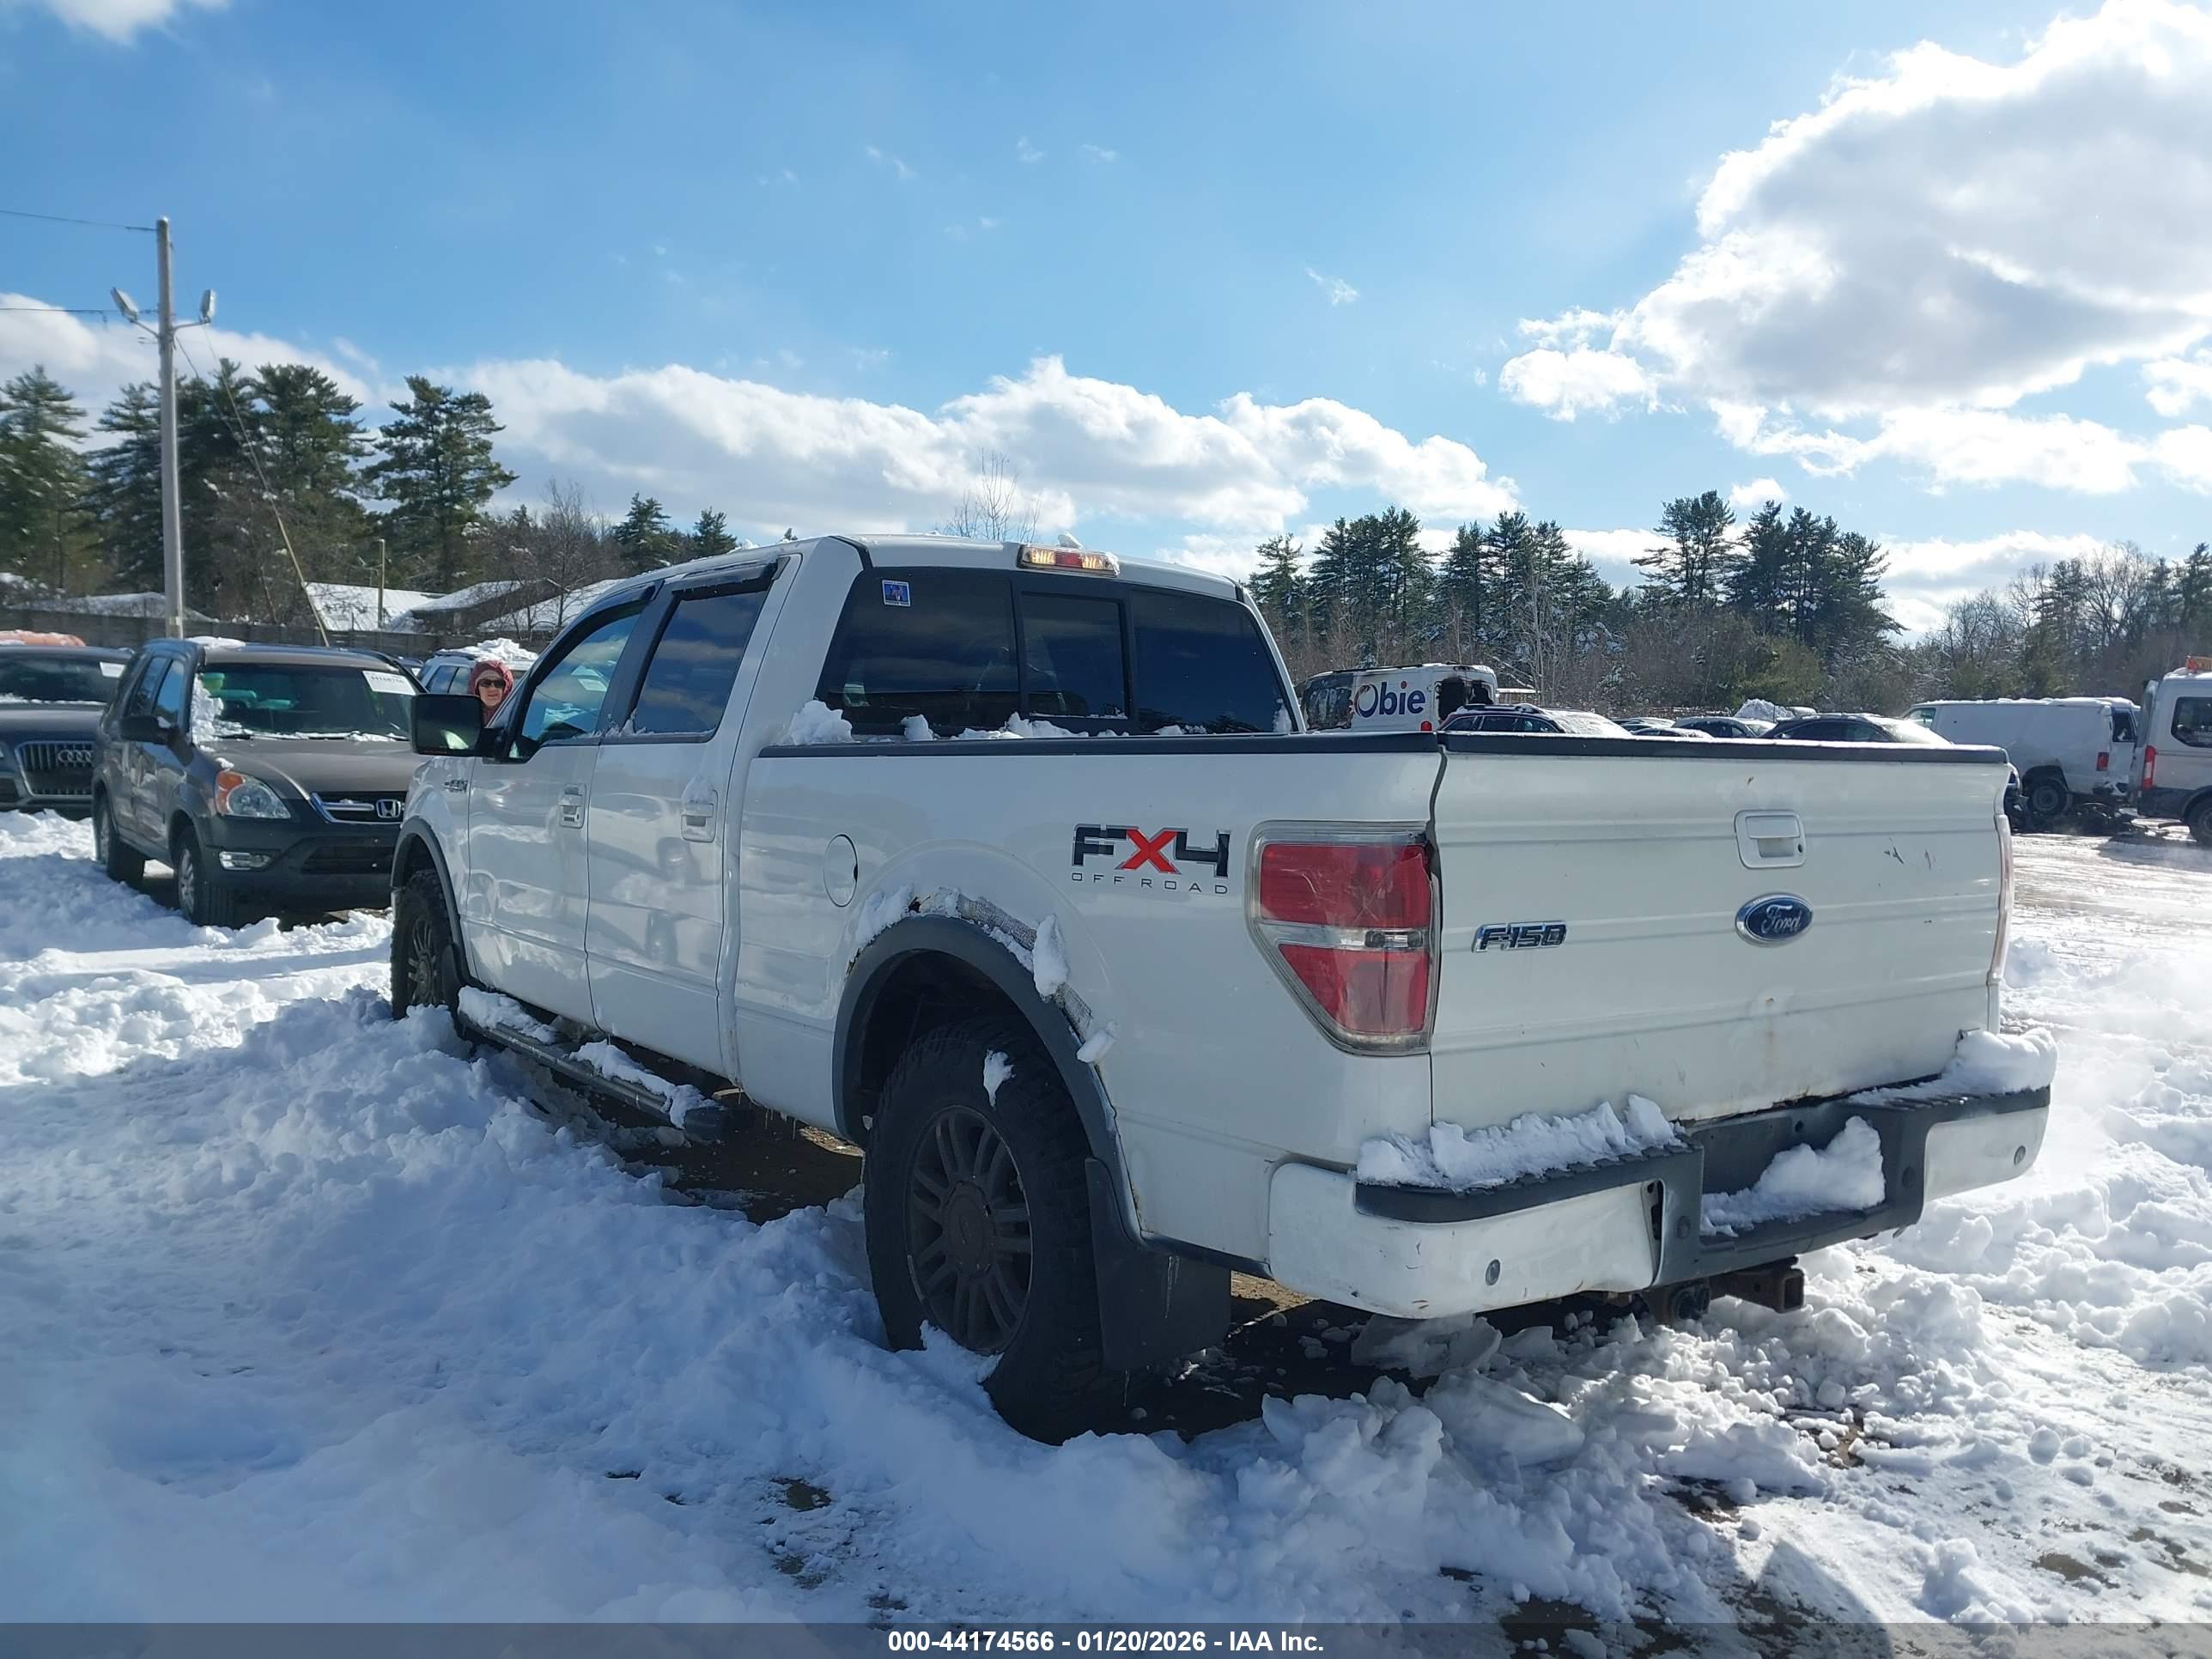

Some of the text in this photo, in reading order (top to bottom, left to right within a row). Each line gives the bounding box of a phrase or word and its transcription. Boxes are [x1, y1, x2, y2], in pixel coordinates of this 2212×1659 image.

[1354, 682, 1425, 718] Obie
[1072, 823, 1231, 878] FX4
[1072, 872, 1228, 895] OFF ROAD
[1761, 904, 1802, 934] Ford
